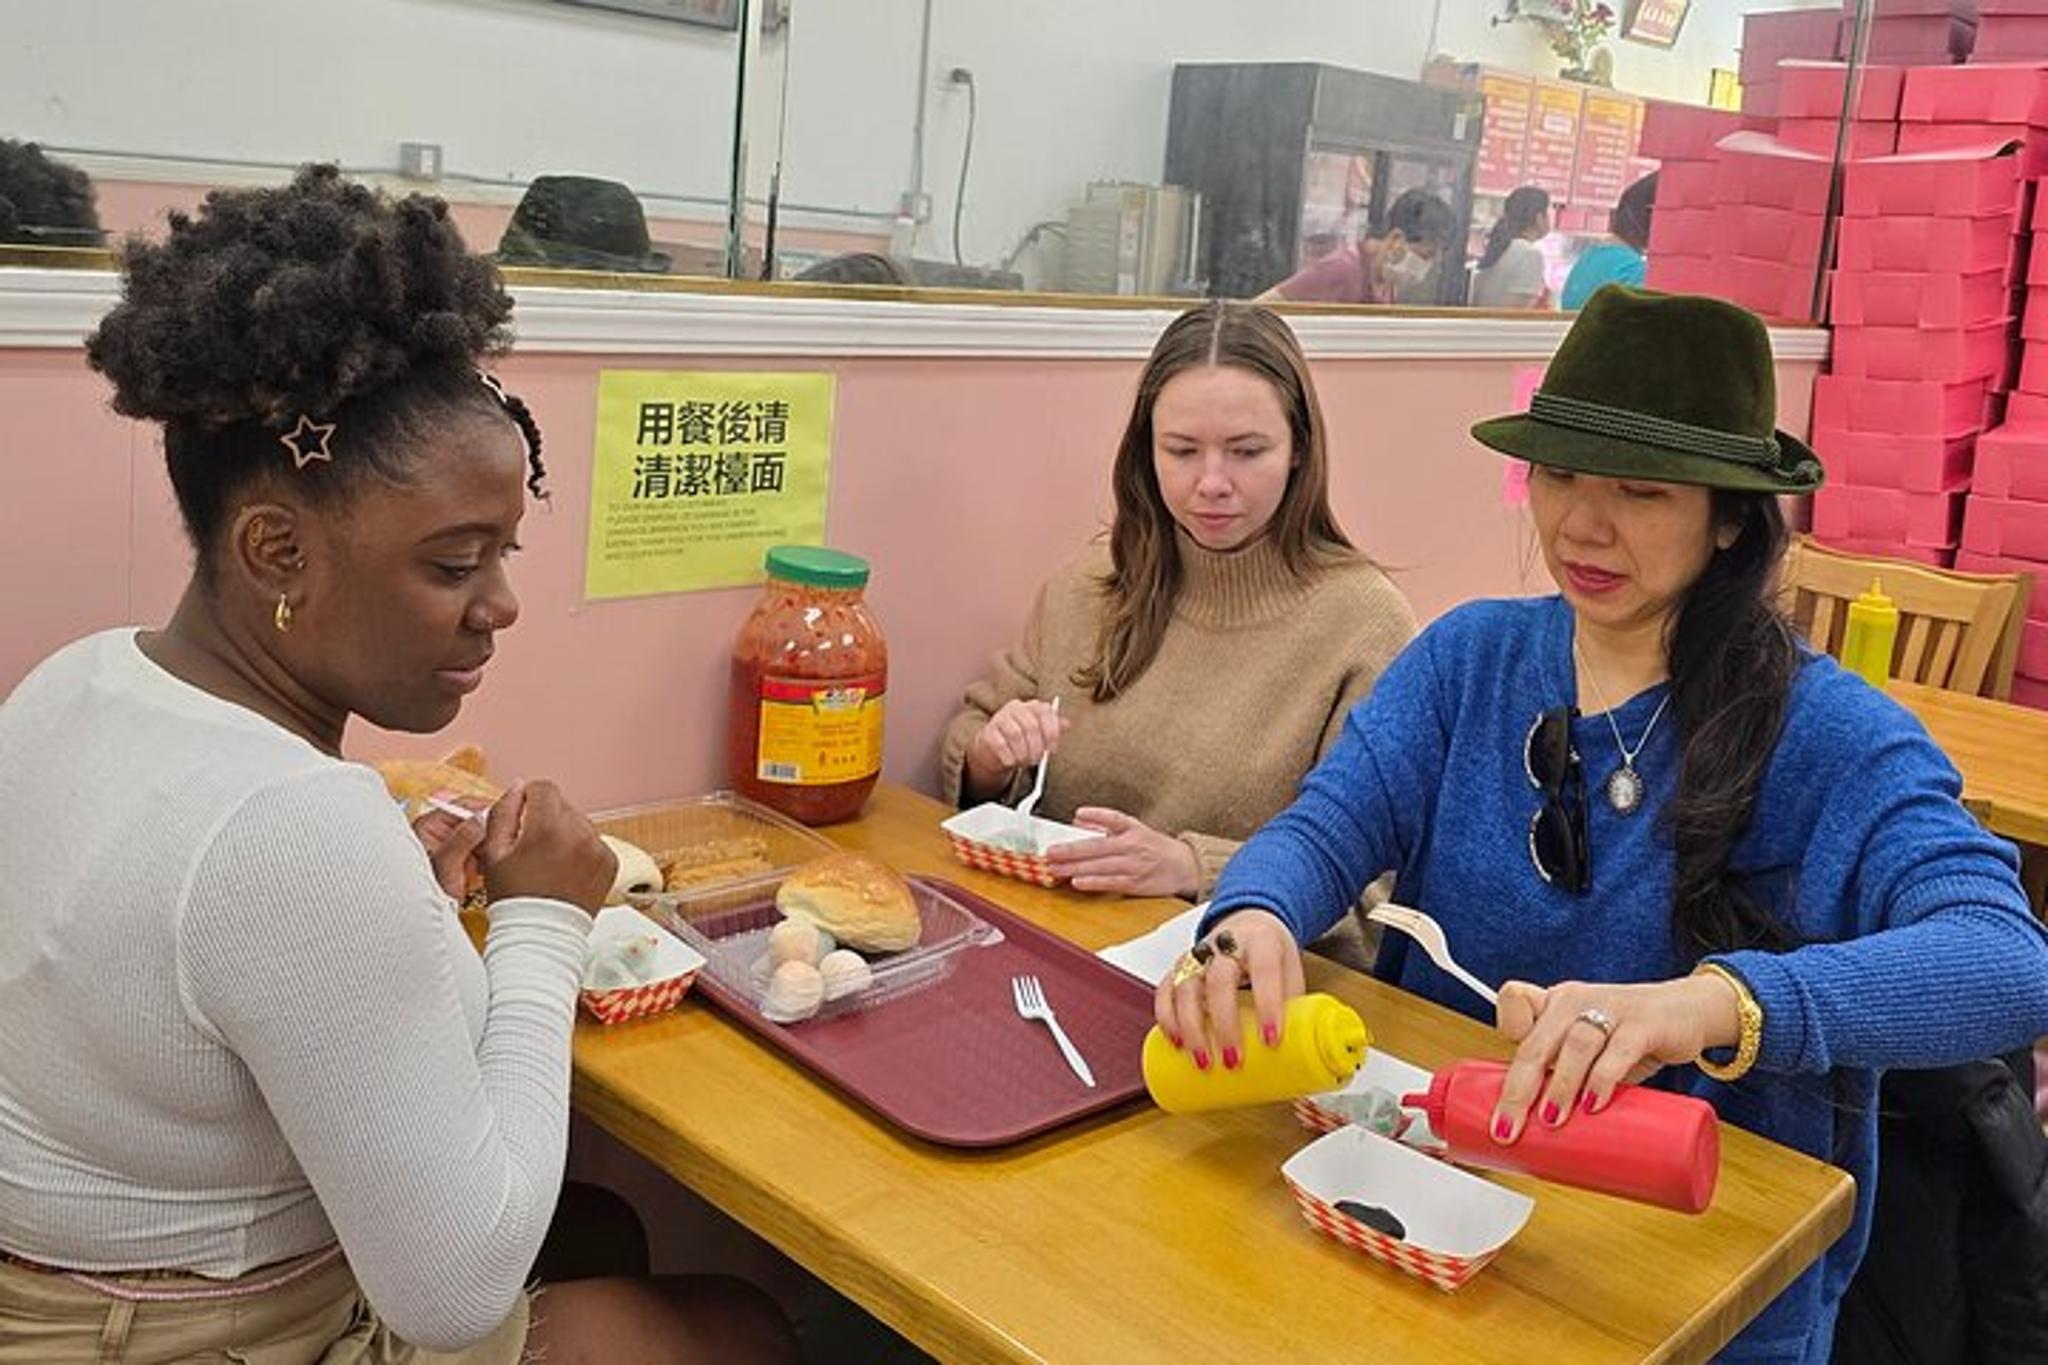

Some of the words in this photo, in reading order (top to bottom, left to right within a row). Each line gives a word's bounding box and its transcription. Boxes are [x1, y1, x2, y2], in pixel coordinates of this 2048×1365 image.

[637, 400, 788, 445] 用餐後请
[633, 451, 786, 499] 清潔檯面
